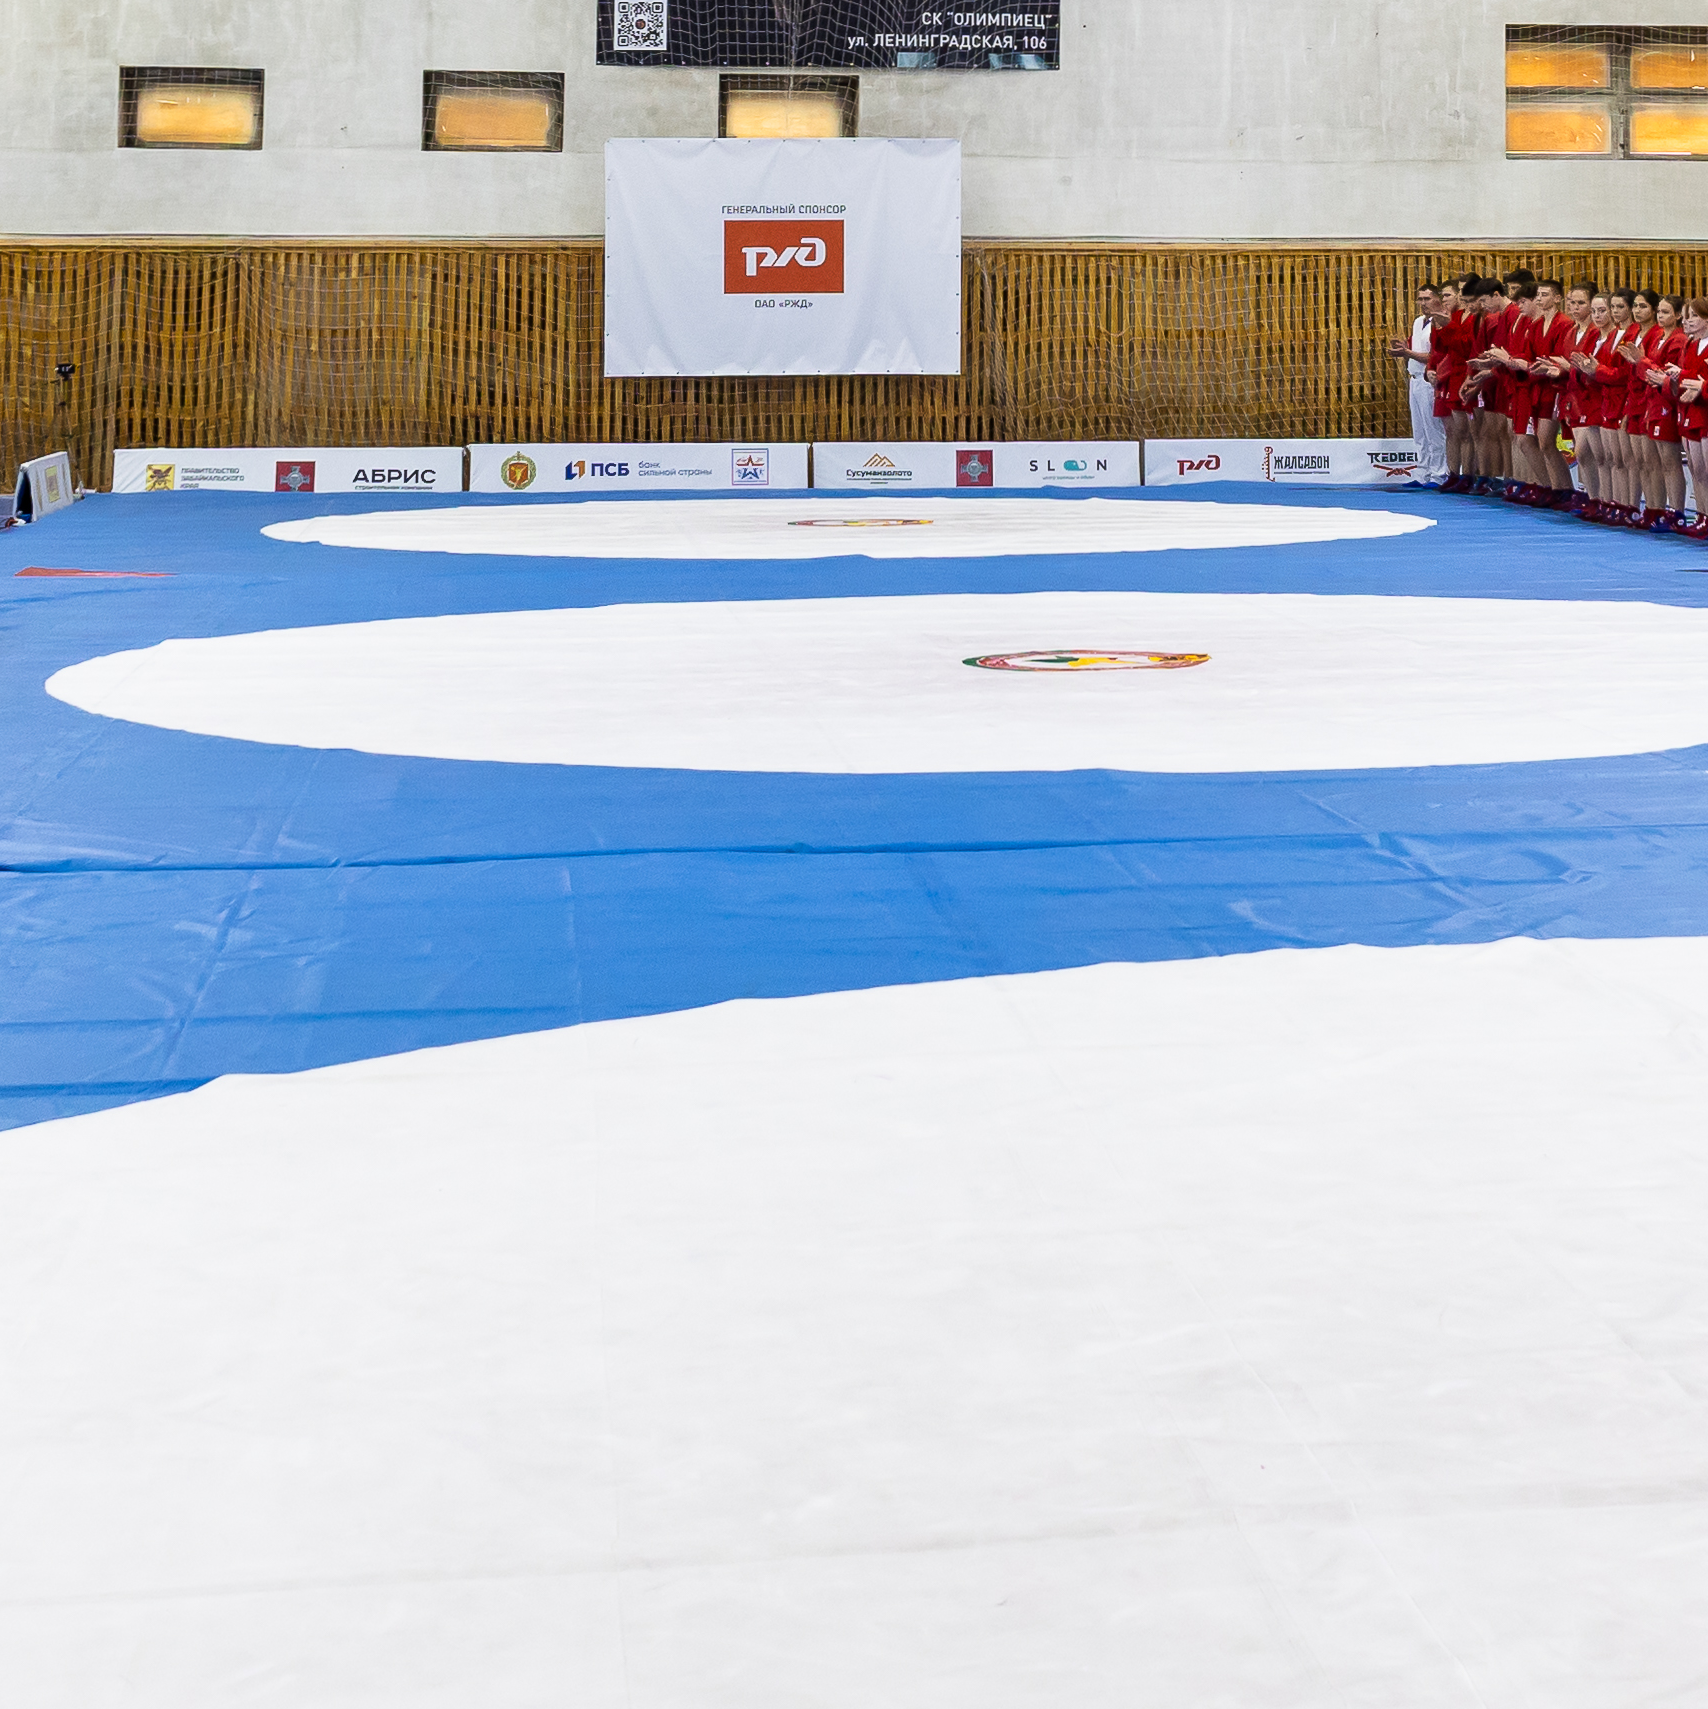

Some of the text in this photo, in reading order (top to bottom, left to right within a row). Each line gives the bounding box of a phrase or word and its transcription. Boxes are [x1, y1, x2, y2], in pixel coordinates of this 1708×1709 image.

[921, 11, 942, 26] СК
[847, 33, 1047, 51] ул. ЛЕНИНГРАДСКАЯ, 106
[721, 203, 847, 215] ГЕНЕРАЛЬНЫЙ СПОНСОР
[754, 298, 814, 310] ОАО «РЖД»
[1273, 455, 1330, 470] ЖАЛСАБОН
[1366, 452, 1419, 464] REDBEL
[352, 468, 437, 484] АБРИС
[590, 462, 630, 477] ПСБ
